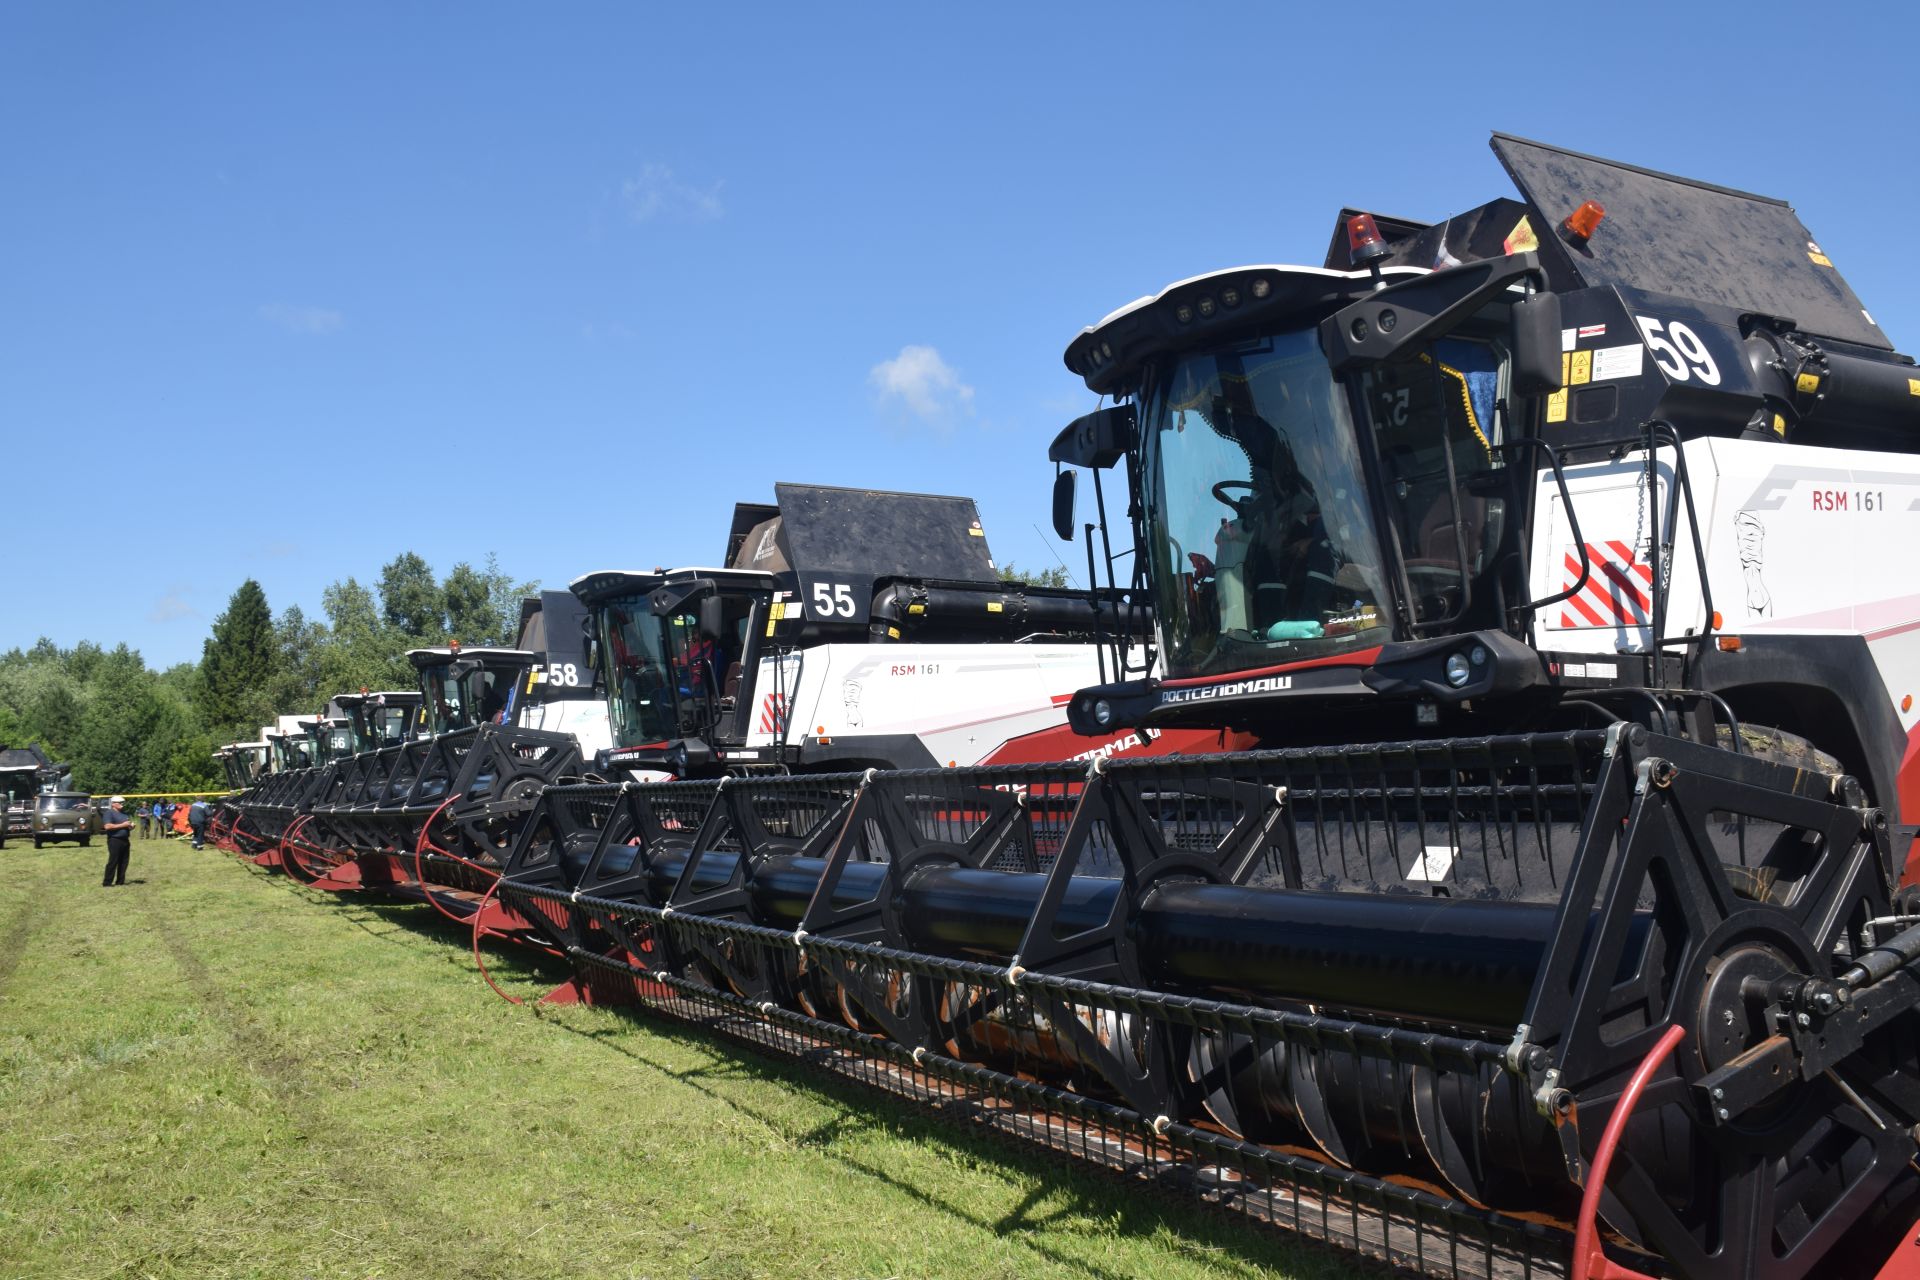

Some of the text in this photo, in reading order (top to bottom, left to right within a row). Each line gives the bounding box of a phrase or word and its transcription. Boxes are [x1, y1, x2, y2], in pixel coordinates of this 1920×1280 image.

[1635, 315, 1721, 386] 59
[1813, 490, 1883, 511] RSM 161
[813, 583, 856, 617] 55
[1328, 613, 1377, 625] SAMURAI
[550, 663, 579, 687] 58
[891, 664, 940, 676] RSM 161
[1162, 676, 1292, 703] РОСТСЕЛЬМАШ
[330, 737, 345, 749] 56
